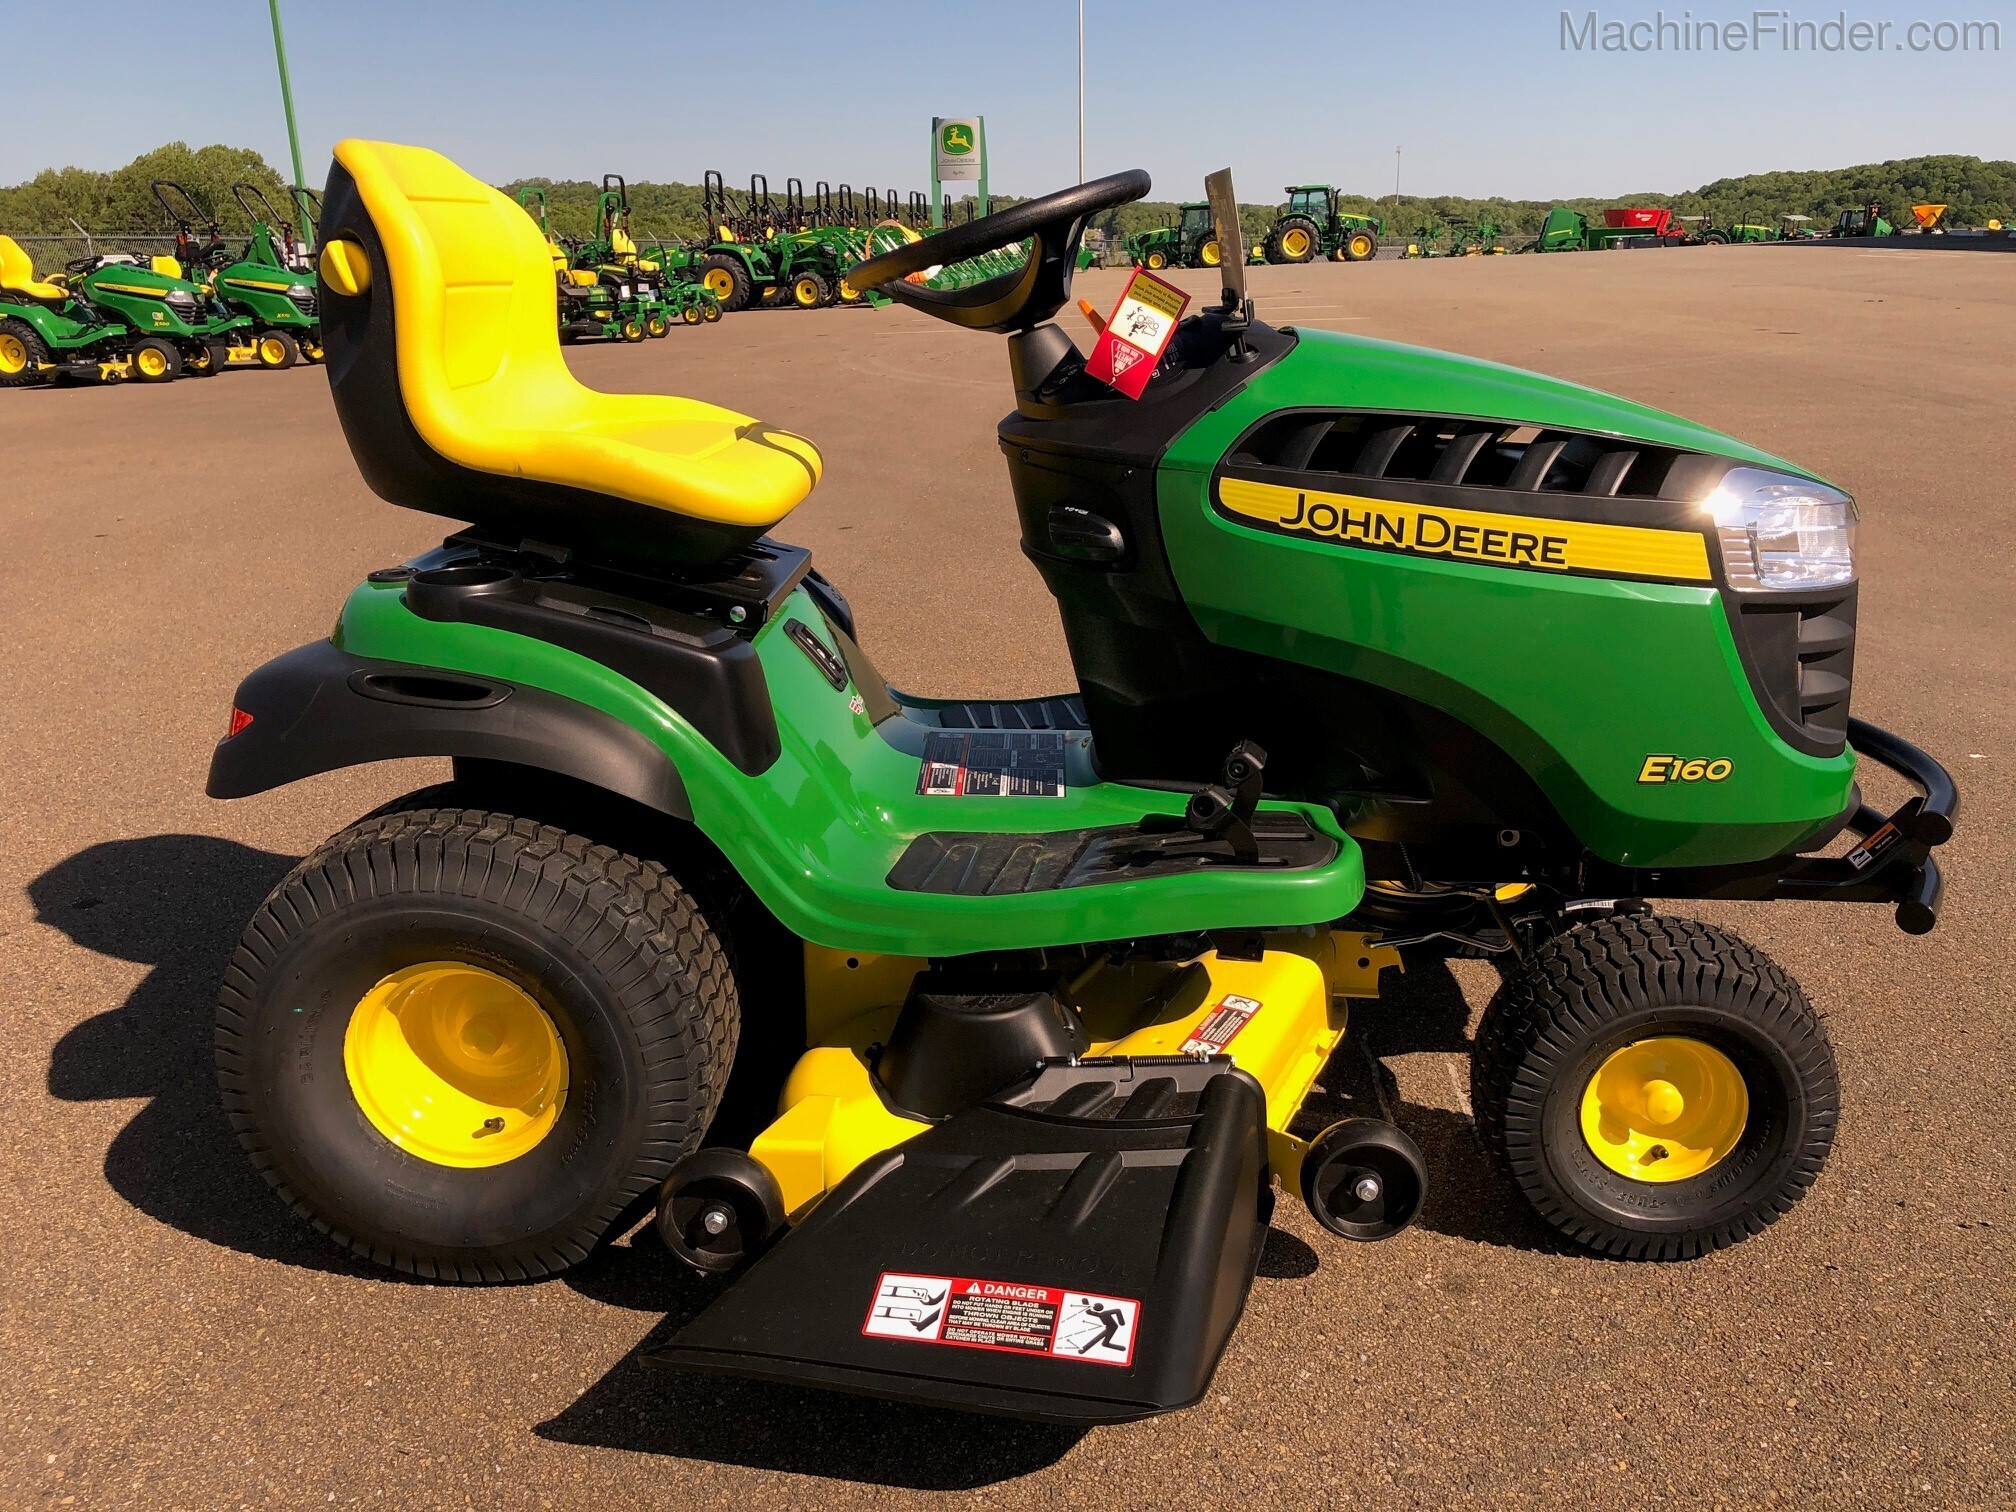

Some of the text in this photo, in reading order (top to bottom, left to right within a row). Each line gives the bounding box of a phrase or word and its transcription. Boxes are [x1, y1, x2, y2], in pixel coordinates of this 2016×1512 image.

[1280, 493, 1568, 566] JOHN DEERE
[1638, 756, 1732, 782] E160
[969, 1296, 1010, 1304] ROTATING
[984, 1284, 1047, 1300] DANGER
[1001, 1315, 1038, 1323] OBJECTS
